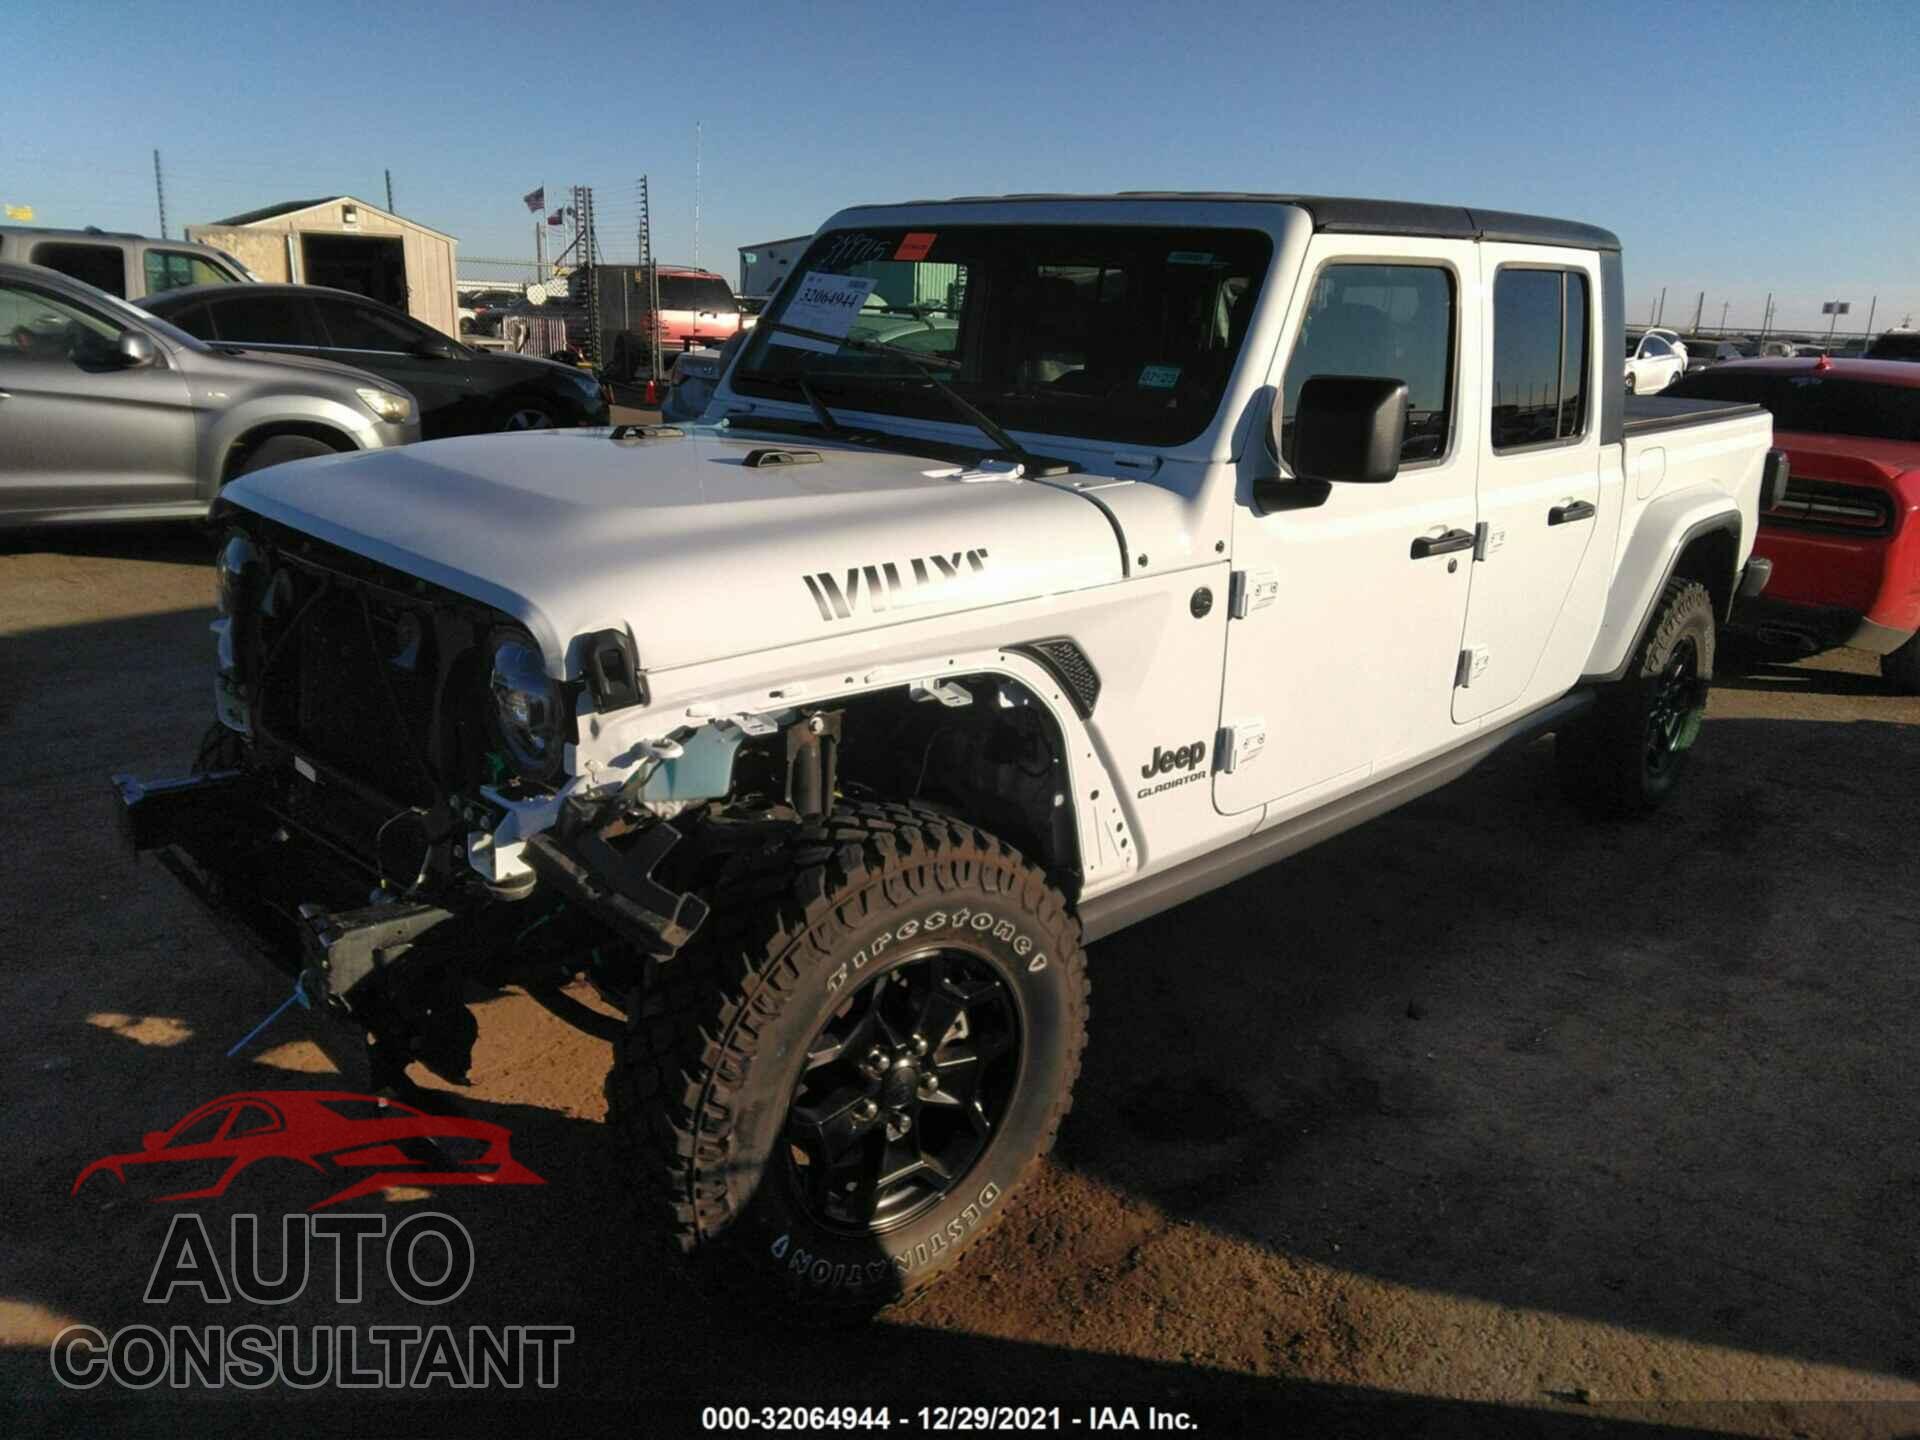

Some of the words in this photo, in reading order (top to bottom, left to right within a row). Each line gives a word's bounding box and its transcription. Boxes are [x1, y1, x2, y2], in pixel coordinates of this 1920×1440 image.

[800, 287, 859, 308] 32064944
[1141, 740, 1206, 779] Jeep
[1137, 770, 1207, 799] GLADIATOR
[826, 906, 1034, 993] Firestone
